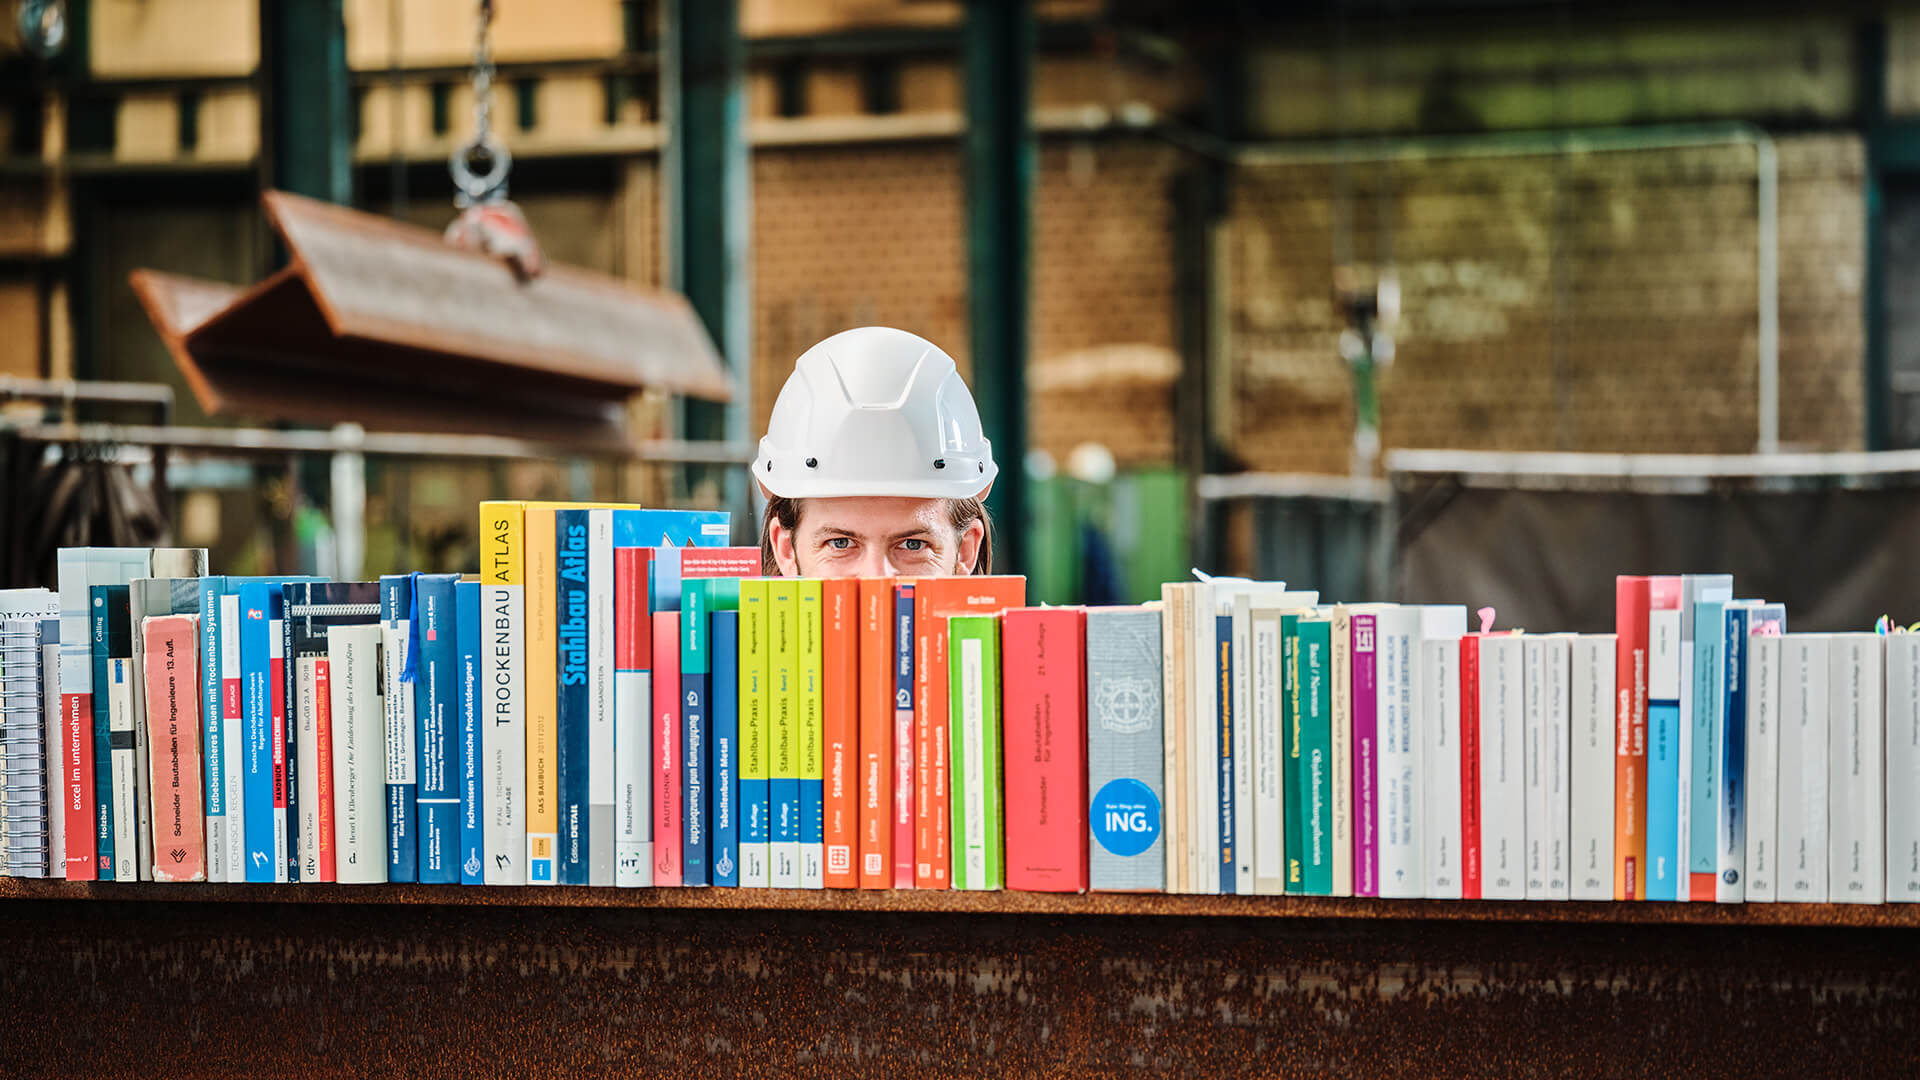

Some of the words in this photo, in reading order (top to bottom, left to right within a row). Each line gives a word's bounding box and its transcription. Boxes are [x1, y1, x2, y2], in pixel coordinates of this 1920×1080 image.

[494, 519, 509, 582] ATLAS
[560, 524, 586, 582] Atlas
[95, 617, 104, 642] Colling
[165, 638, 174, 658] Aufl.
[206, 590, 217, 686] Trockenbau-Systemen
[560, 590, 586, 686] Stahlbau
[1037, 622, 1046, 659] Auflage
[167, 658, 175, 671] 13.
[495, 590, 511, 727] TROCKENBAU
[920, 636, 928, 683] Mathematik
[1038, 665, 1046, 676] 21.
[168, 676, 178, 721] Ingenieure
[208, 688, 217, 702] mit
[249, 672, 257, 739] Dachdeckerhandwerk
[257, 671, 265, 717] Abdichtungen
[303, 695, 310, 705] 23
[465, 661, 474, 732] Produktdesigner
[597, 665, 605, 722] KALKSANDSTEIN
[920, 686, 928, 727] Grundkurs
[1310, 676, 1320, 717] Newman
[1633, 649, 1646, 724] Management
[69, 696, 80, 765] unternehmen
[169, 724, 178, 735] für
[209, 704, 218, 732] Bauen
[346, 707, 355, 751] Entdeckung
[750, 699, 759, 773] Stahlbau-Praxis
[780, 698, 788, 772] Stahlbau-Praxis
[807, 698, 815, 773] Stahlbau-Praxis
[1034, 703, 1042, 762] Bautabellen
[1043, 693, 1052, 746] Ingenieure
[1618, 689, 1629, 756] Praxisbuch
[171, 737, 180, 788] Bautabellen
[319, 737, 327, 751] des
[347, 752, 355, 765] Die
[466, 733, 474, 779] Technische
[663, 713, 671, 770] Tabellenbuch
[689, 715, 700, 767] Buchführung
[720, 738, 728, 768] Metall
[832, 742, 842, 750] 2
[1043, 749, 1051, 762] für
[1362, 738, 1370, 757] Kraft
[1633, 726, 1643, 756] Lean
[71, 768, 80, 781] im
[210, 734, 220, 813] Erdbebensicheres
[229, 775, 238, 811] REGELN
[319, 751, 327, 795] Strukturen
[348, 767, 356, 812] Ellenberger
[537, 757, 545, 796] BAUBUCH
[689, 768, 700, 784] und
[832, 751, 842, 798] Stahlbau
[868, 762, 878, 808] Stahlbau
[920, 769, 928, 784] und
[71, 784, 81, 810] excel
[172, 793, 181, 837] Schneider
[466, 780, 475, 829] Fachwissen
[625, 784, 633, 835] Bauzeichnen
[663, 772, 671, 828] BAUTECHNIK
[689, 786, 700, 845] Finanzberichte
[720, 769, 729, 829] Tabellenbuch
[1039, 776, 1048, 826] Schneider
[1311, 749, 1322, 866] Objektbeziehungstheorien
[1362, 790, 1370, 801] als
[100, 804, 108, 839] Holzbau
[231, 814, 240, 872] TECHNISCHE
[348, 823, 356, 844] Henri
[570, 804, 579, 838] DETAIL
[1105, 812, 1153, 832] ING.
[1363, 803, 1372, 845] Imagination
[305, 857, 315, 876] dtv
[570, 838, 579, 864] Edition
[621, 859, 638, 867] HT
